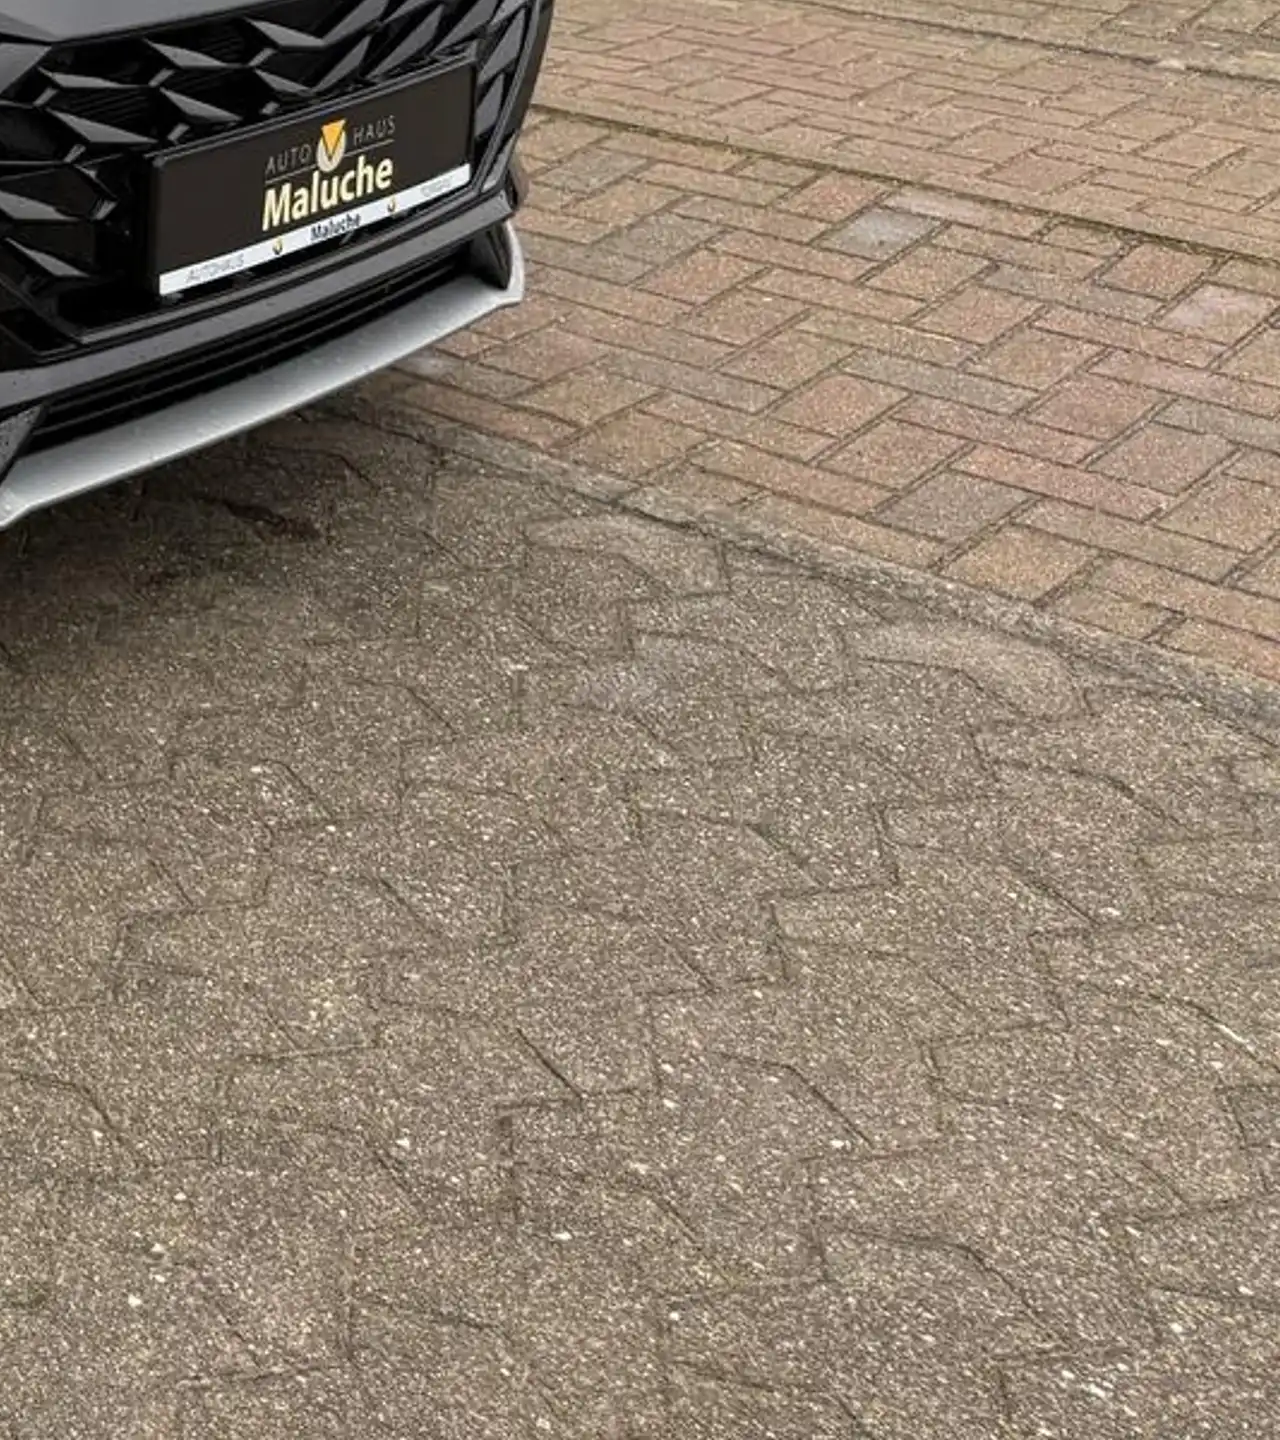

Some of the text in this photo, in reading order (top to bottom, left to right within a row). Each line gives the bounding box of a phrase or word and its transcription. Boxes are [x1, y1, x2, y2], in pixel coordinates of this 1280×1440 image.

[264, 114, 397, 177] AUTO HAUS
[262, 154, 394, 232] Maluche
